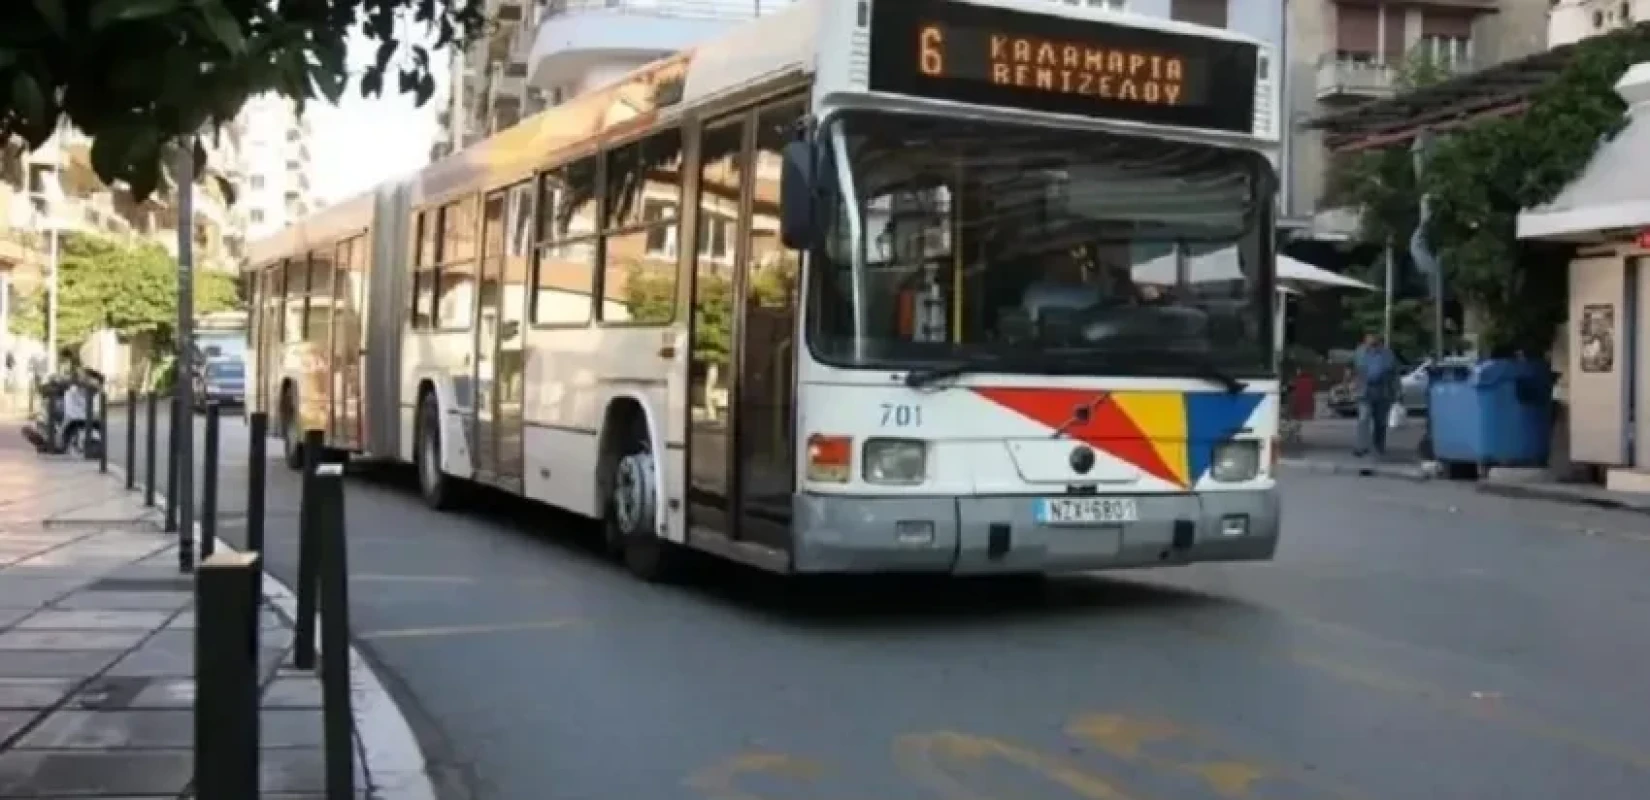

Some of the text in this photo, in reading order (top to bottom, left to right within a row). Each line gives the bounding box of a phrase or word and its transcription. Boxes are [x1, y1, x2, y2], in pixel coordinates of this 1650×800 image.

[919, 26, 943, 76] 6
[990, 34, 1182, 80] ΚΑΛΑΜΑΡΙΑ
[880, 404, 923, 427] 701
